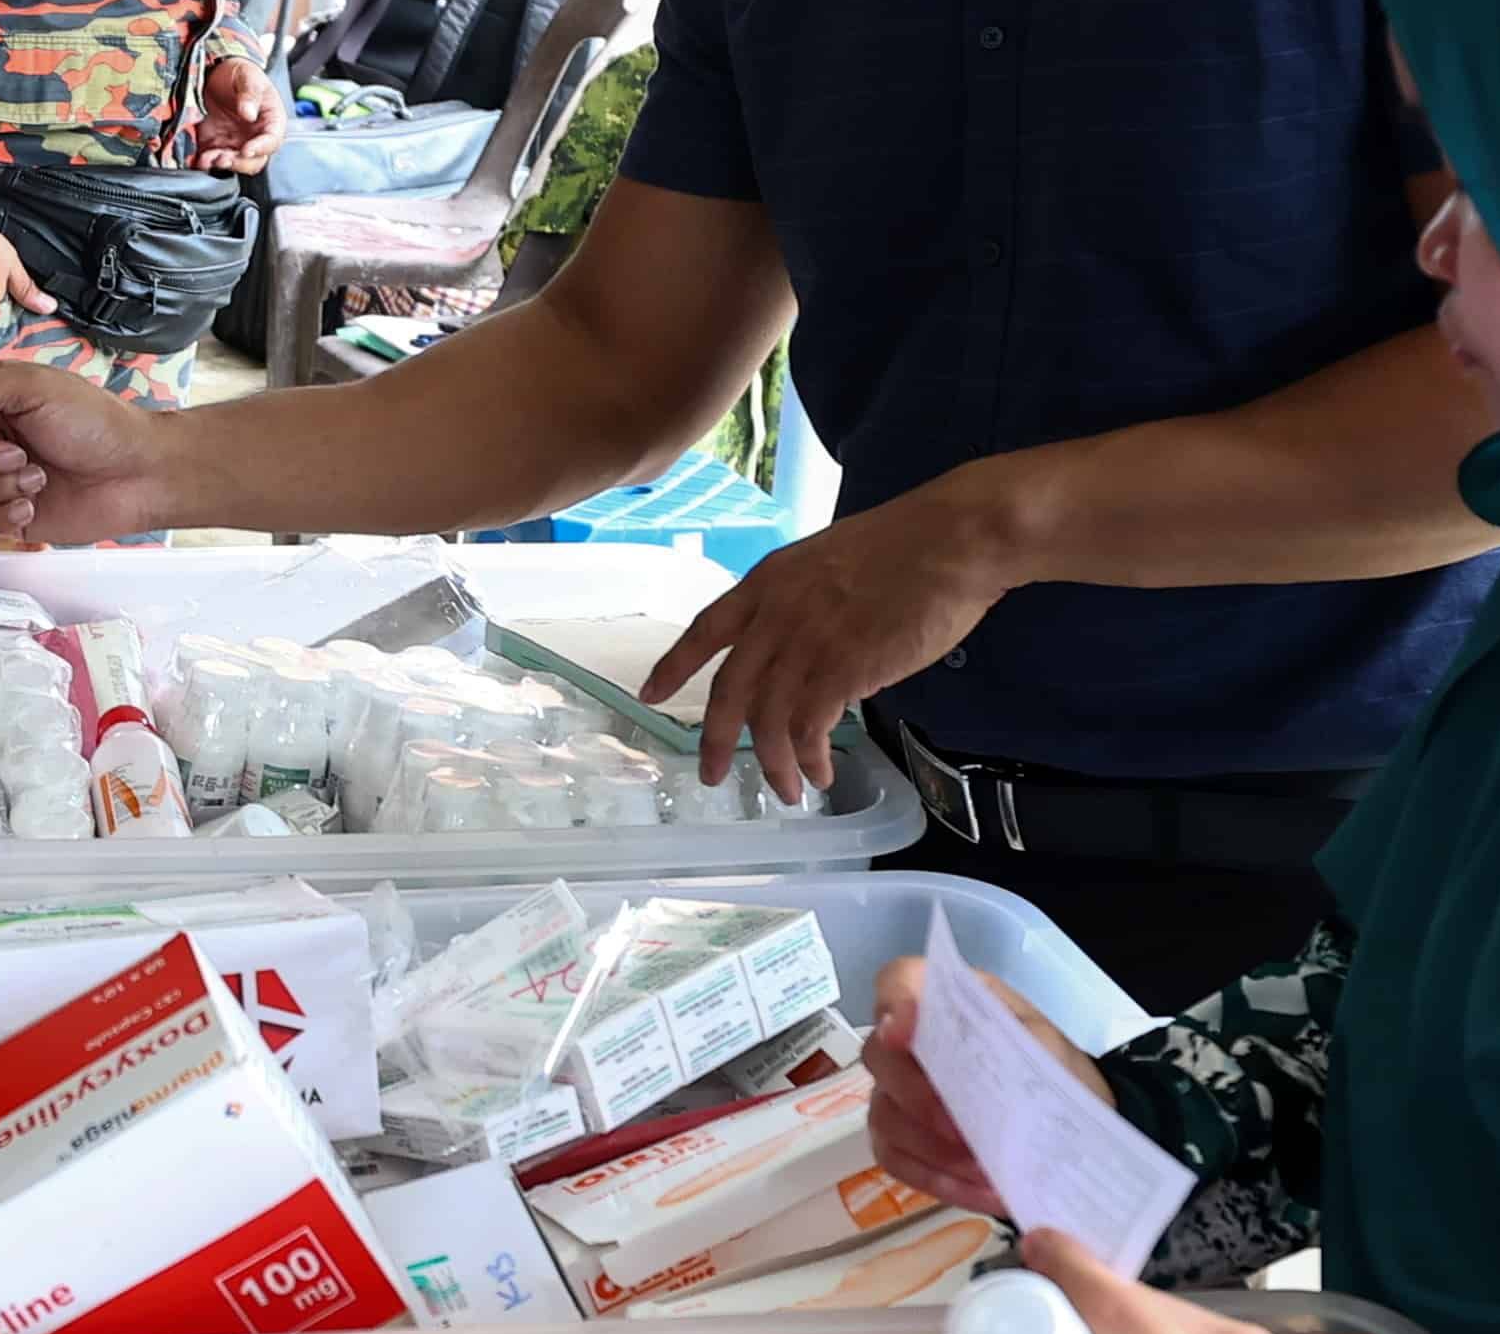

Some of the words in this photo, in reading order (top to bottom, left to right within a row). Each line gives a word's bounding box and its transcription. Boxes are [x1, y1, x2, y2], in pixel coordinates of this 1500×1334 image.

[70, 1049, 225, 1153] pharmaniaga
[240, 1247, 321, 1308] 100
[293, 1277, 341, 1312] mg
